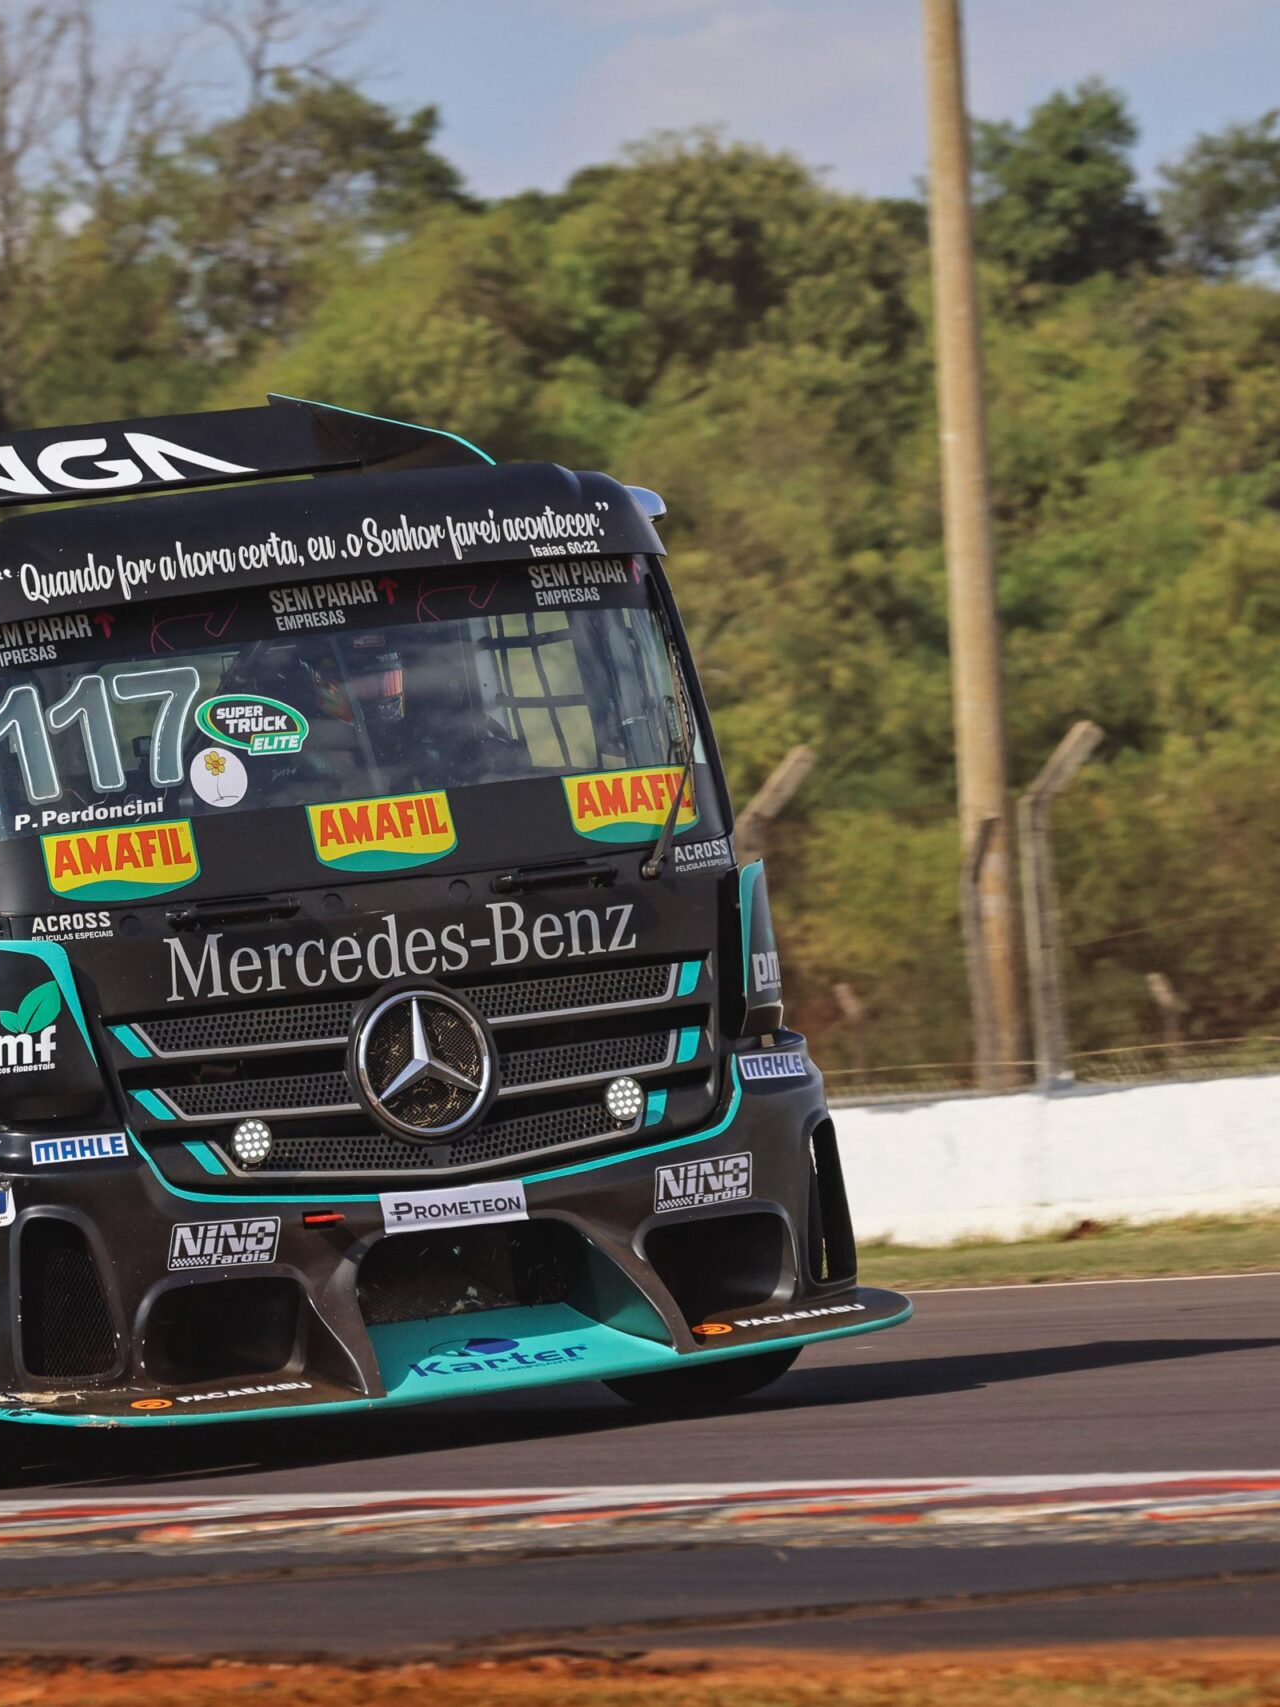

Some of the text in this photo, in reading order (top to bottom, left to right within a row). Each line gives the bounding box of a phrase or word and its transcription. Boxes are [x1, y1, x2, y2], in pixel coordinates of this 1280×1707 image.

[116, 554, 156, 600] for
[159, 555, 177, 581] a
[176, 541, 236, 579] hora
[361, 514, 446, 558] Senhor
[446, 508, 501, 561] farei
[529, 540, 600, 558] Isaías 60:22
[527, 558, 628, 589] SEM PARAR
[269, 579, 378, 614] SEM PARAR
[535, 586, 601, 606] EMPRESAS
[24, 613, 93, 645] PARAR
[275, 609, 346, 632] EMPRESAS
[215, 705, 263, 720] SUPER
[225, 714, 288, 734] TRUCK
[252, 735, 300, 751] ELITE
[577, 773, 693, 820] AMAFIL
[14, 797, 164, 832] P. Perdoncini
[319, 797, 449, 848] AMAFIL
[54, 827, 192, 879] AMAFIL
[674, 838, 728, 863] ACROSS
[32, 911, 112, 933] ACROSS
[75, 930, 114, 940] ESPECIAIS
[162, 900, 638, 1003] Mercedes-Benz
[743, 1052, 803, 1079] MAHLE
[34, 1135, 126, 1162] MAHLE
[694, 1187, 747, 1205] Faróis
[388, 1196, 521, 1222] PROMETEON
[210, 1250, 271, 1265] Faróis
[733, 1303, 867, 1328] PACAEMBU
[409, 1344, 588, 1378] Karter
[175, 1381, 313, 1404] PACAEMBU
